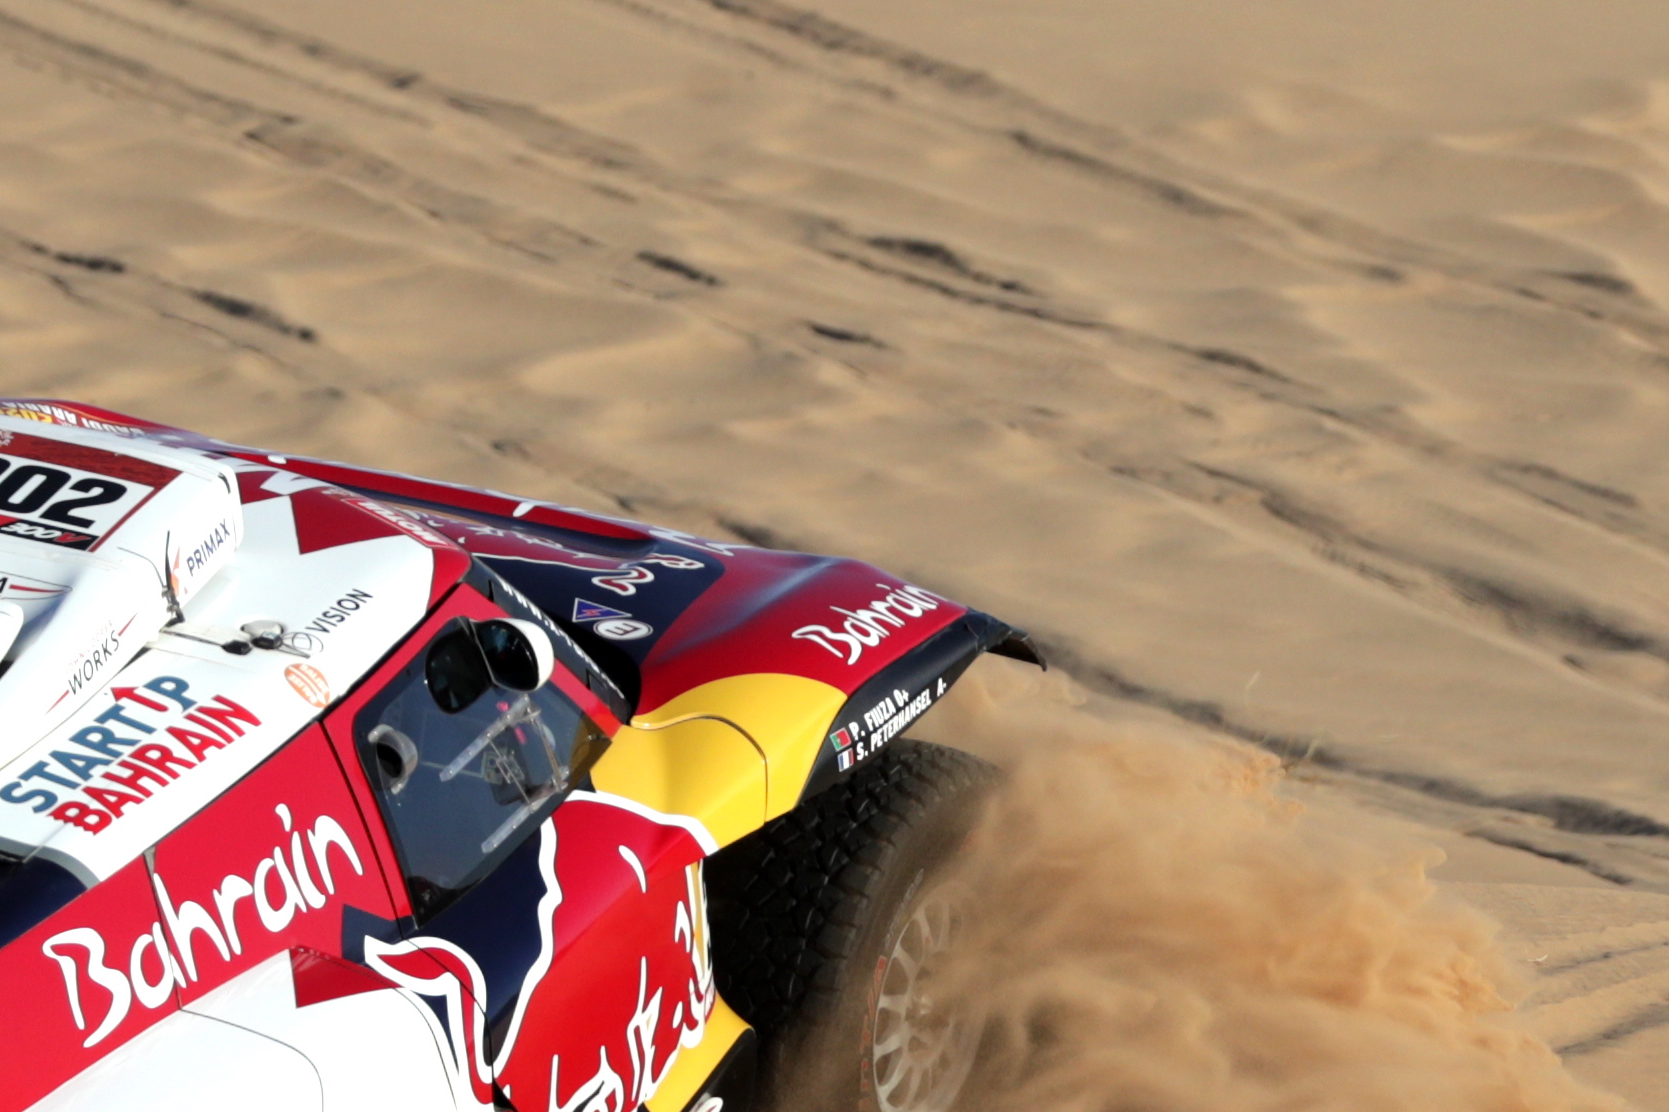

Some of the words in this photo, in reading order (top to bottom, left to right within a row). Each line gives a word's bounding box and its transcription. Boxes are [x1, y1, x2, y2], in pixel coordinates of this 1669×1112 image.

[0, 521, 93, 545] 300V
[186, 518, 231, 577] PRIMAX
[305, 588, 373, 634] VISION
[791, 583, 949, 665] Bahrain
[68, 629, 120, 695] WORKS
[849, 720, 865, 741] P.
[864, 696, 896, 732] FIUZA
[856, 741, 869, 761] S.
[870, 688, 932, 752] PETERHANSEL
[45, 694, 262, 836] BAHRAIN
[42, 803, 364, 1048] Bahrain
